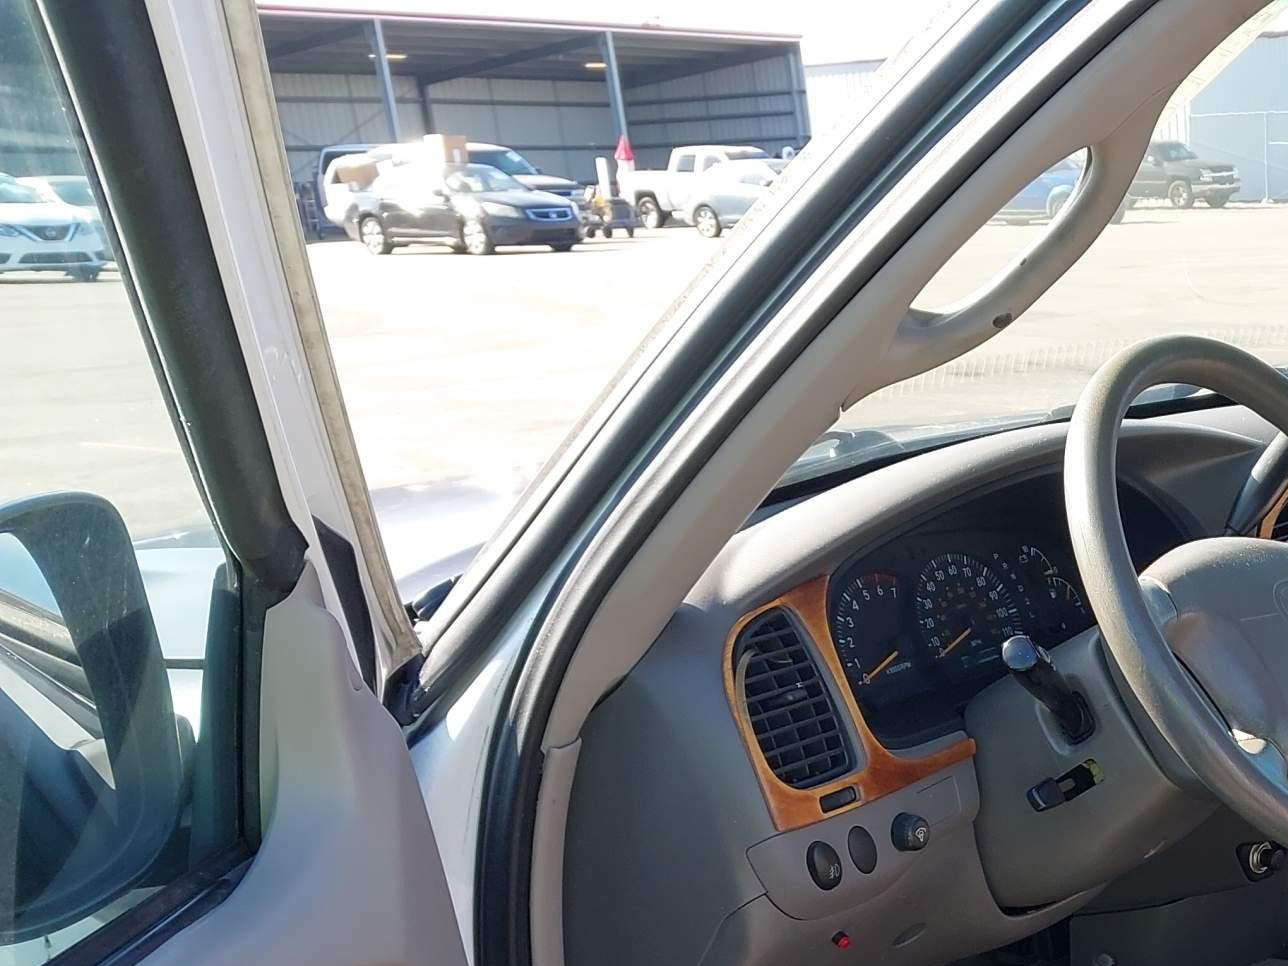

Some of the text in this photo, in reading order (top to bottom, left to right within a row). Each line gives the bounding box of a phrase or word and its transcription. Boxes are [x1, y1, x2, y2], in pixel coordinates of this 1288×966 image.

[934, 569, 945, 581] 50
[948, 564, 958, 576] 60
[962, 567, 972, 578] 70
[926, 581, 936, 593] 40
[976, 576, 987, 588] 80
[862, 589, 870, 601] 5
[876, 584, 884, 596] 6
[890, 587, 897, 600] 7
[852, 600, 860, 611] 4
[922, 598, 933, 610] 30
[846, 616, 855, 628] 3
[924, 617, 935, 629] 20
[846, 637, 855, 649] 2
[930, 636, 941, 647] 10
[854, 658, 861, 669] 1
